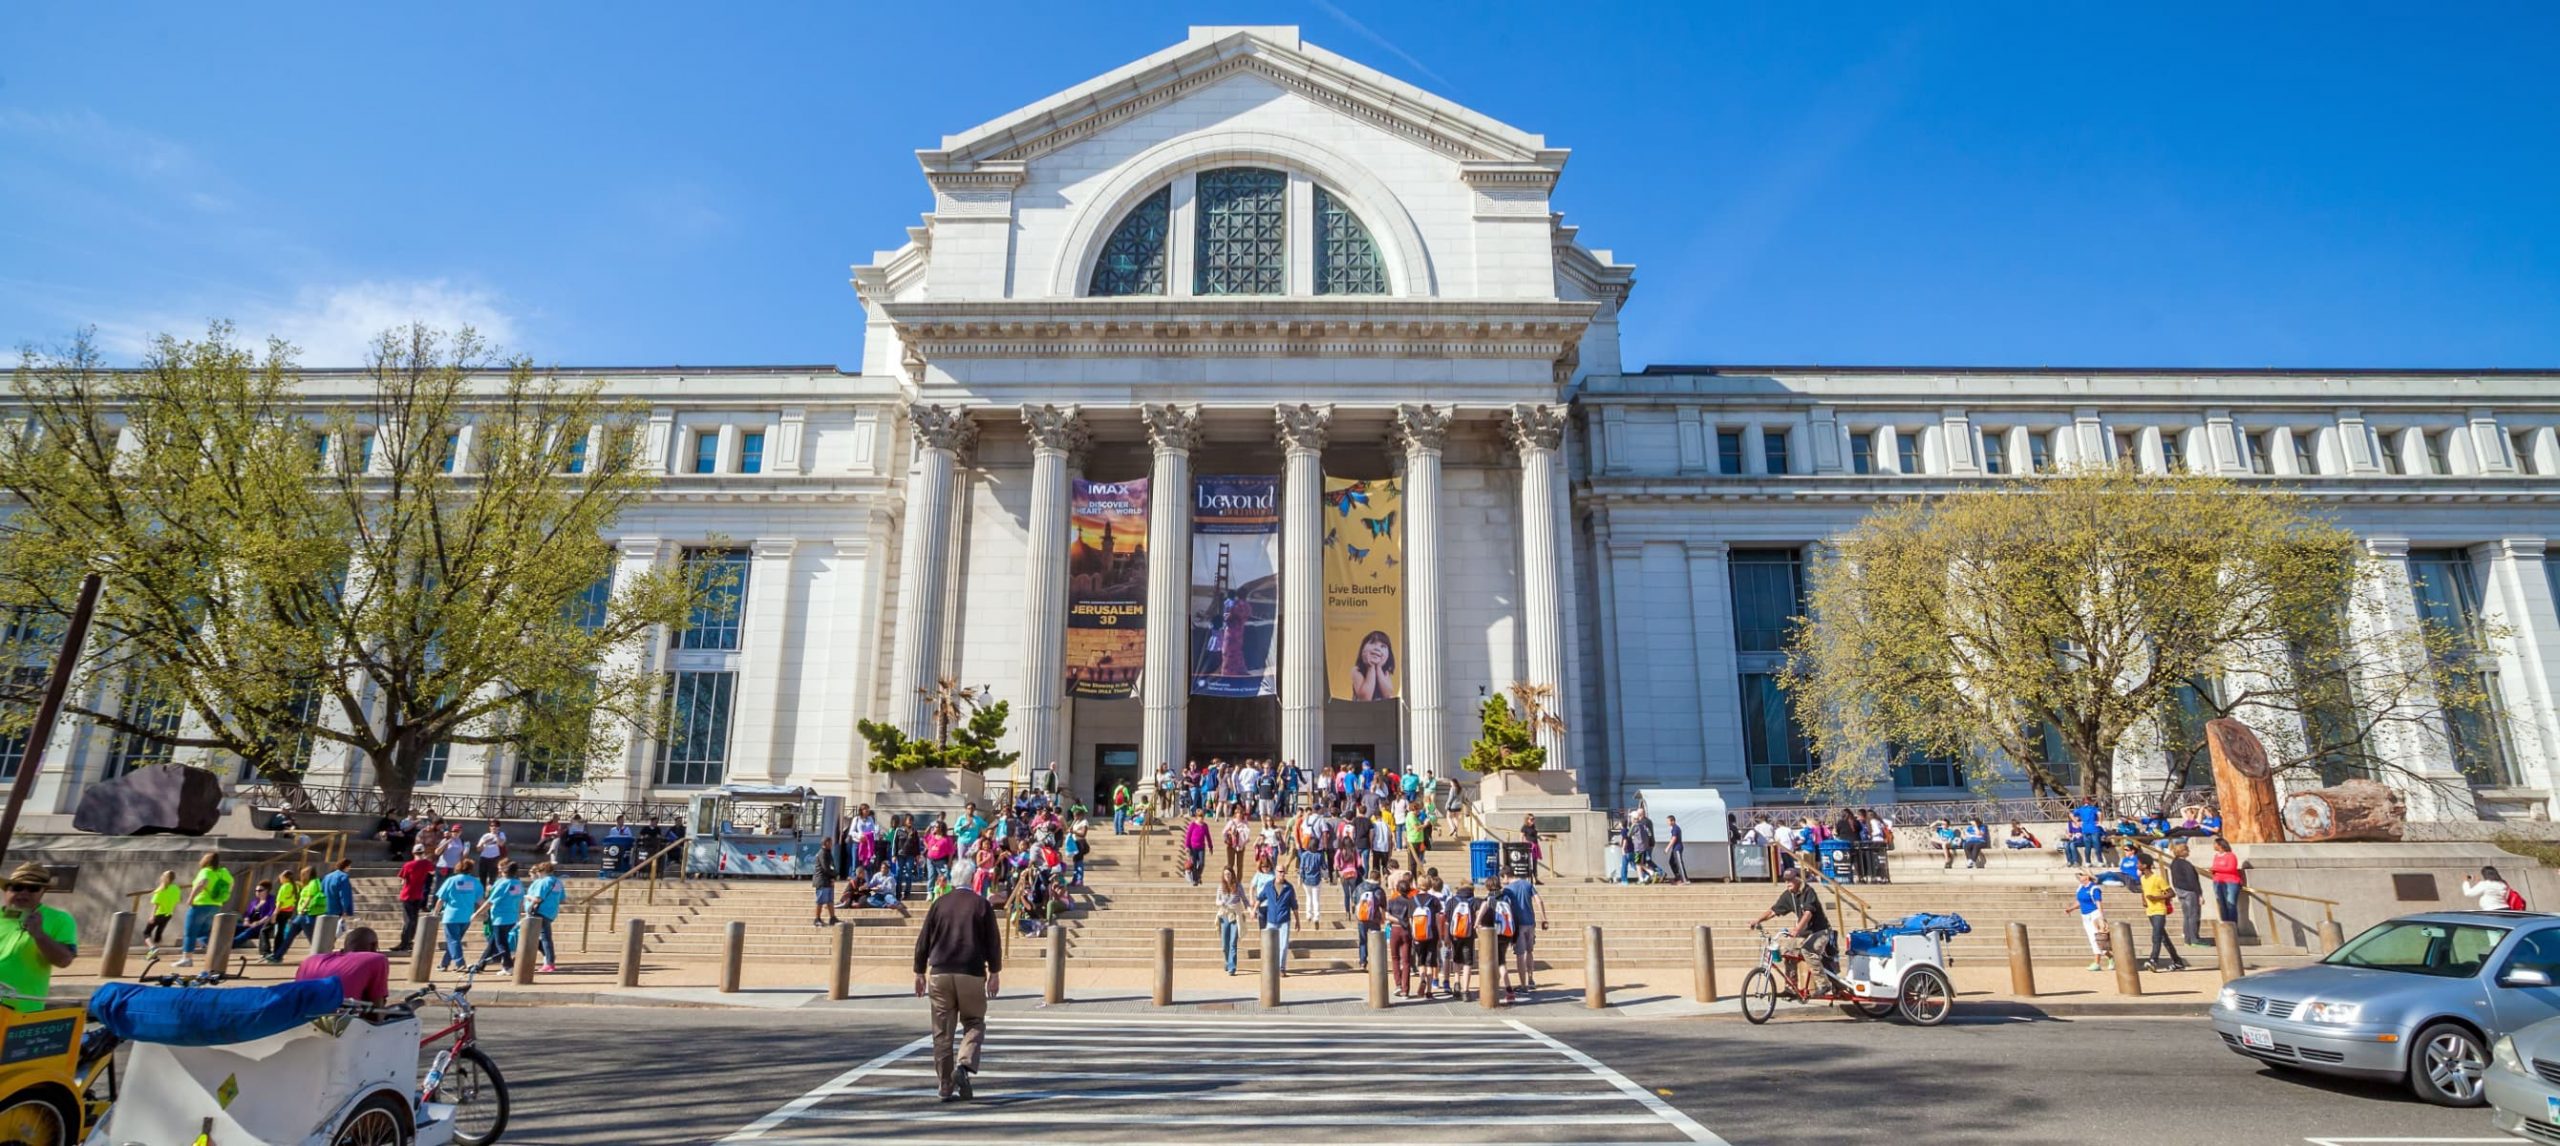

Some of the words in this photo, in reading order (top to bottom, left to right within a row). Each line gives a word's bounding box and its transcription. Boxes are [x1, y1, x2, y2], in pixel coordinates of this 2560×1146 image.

[1088, 484, 1129, 494] IMAX
[1198, 484, 1274, 510] beyond
[1329, 584, 1349, 594] Live
[1352, 584, 1396, 596] Butterfly
[1329, 596, 1368, 607] Pavilion
[1071, 605, 1143, 615] JERUSALEM
[1100, 615, 1117, 625] 3D
[8, 1022, 71, 1038] RIDESCOUT
